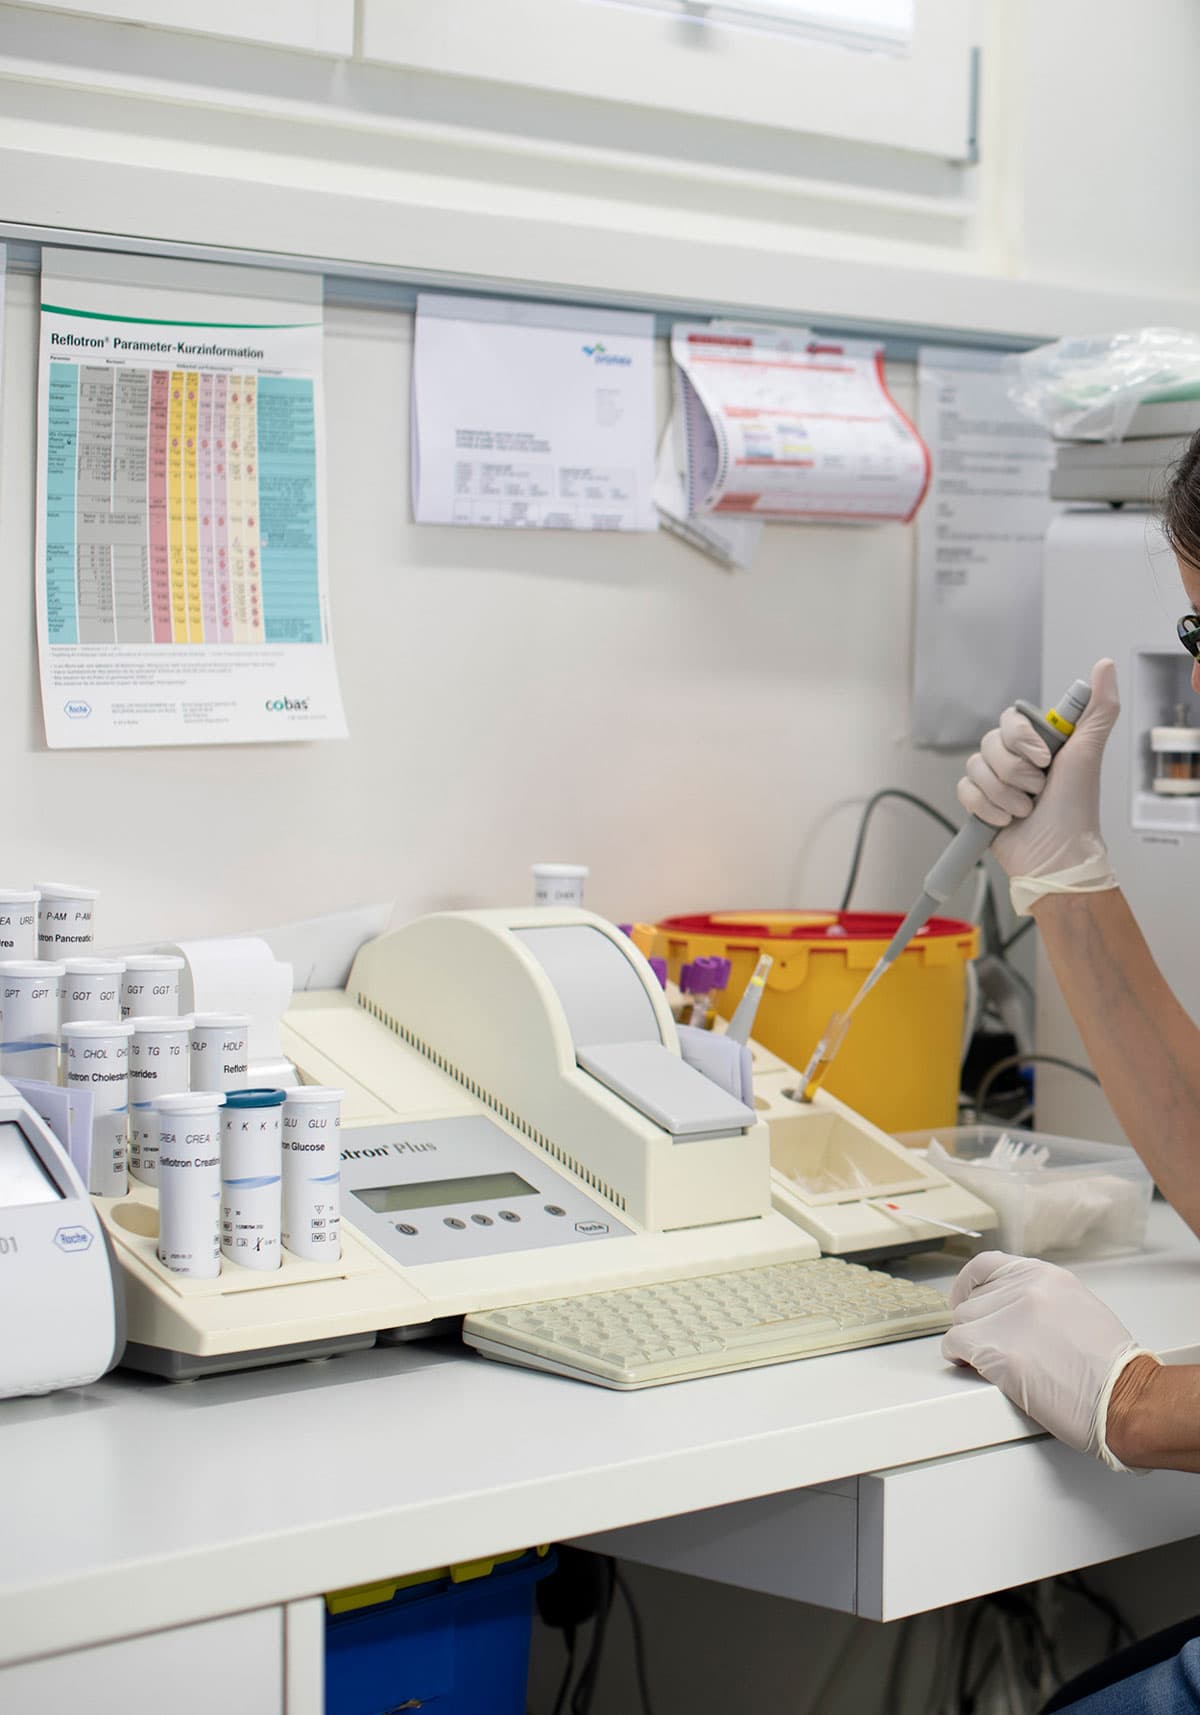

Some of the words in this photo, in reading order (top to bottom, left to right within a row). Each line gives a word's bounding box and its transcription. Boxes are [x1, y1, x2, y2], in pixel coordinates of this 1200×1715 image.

[113, 337, 264, 359] Parameter-Kurzinformation
[32, 989, 49, 999] GPT
[127, 985, 145, 995] GGT
[153, 985, 170, 996] GGT
[72, 991, 92, 1001] GOT
[148, 1046, 160, 1056] TG
[169, 1046, 180, 1056] TG
[222, 1041, 245, 1051] HDLP
[83, 1049, 108, 1059] CHOL
[242, 1122, 249, 1131] K
[308, 1119, 327, 1129] GLU
[185, 1133, 210, 1144] CREA
[291, 1141, 326, 1152] Glucose
[393, 1141, 438, 1155] Plus
[60, 1231, 88, 1246] Roche
